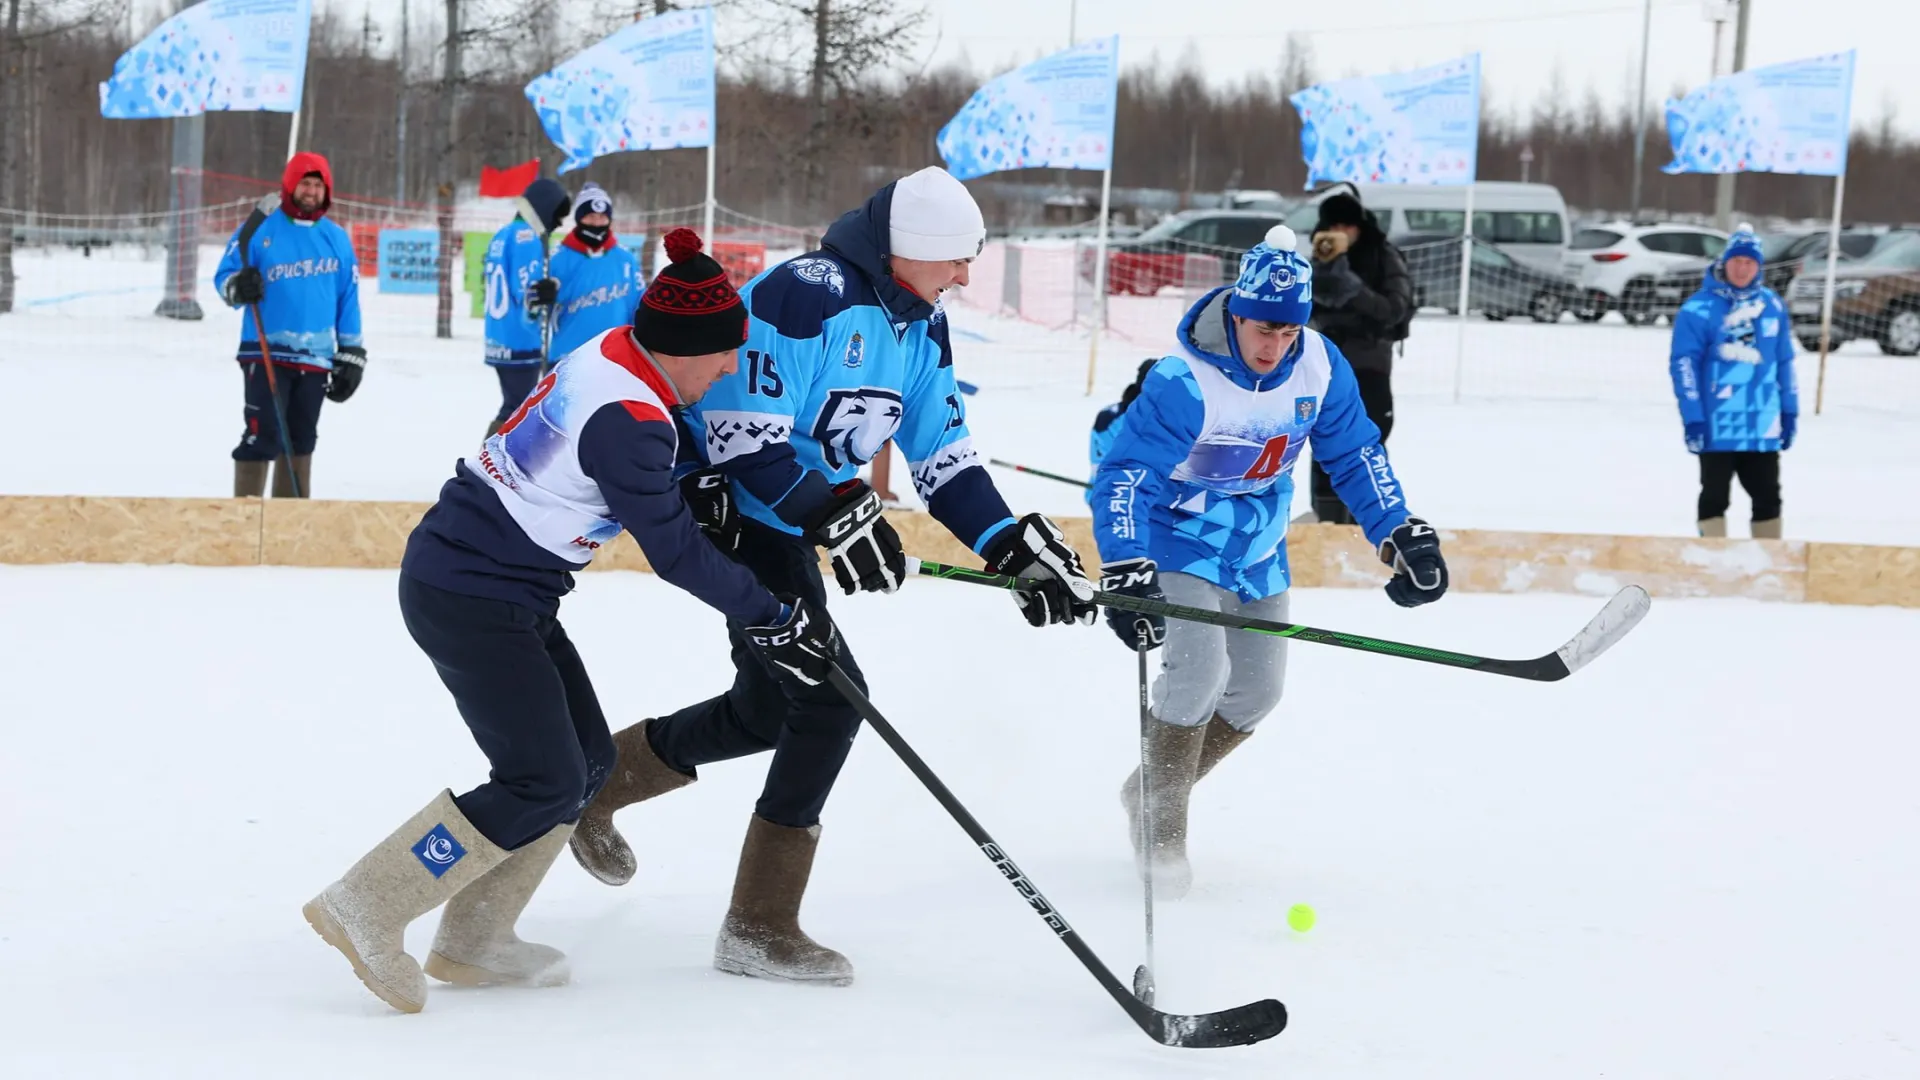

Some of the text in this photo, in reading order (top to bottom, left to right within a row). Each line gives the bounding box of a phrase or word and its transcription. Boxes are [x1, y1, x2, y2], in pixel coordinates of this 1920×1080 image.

[746, 350, 785, 399] 15
[1242, 432, 1290, 481] 4
[1371, 454, 1402, 508] ЯМАЛ
[997, 550, 1014, 571] CCM
[1102, 570, 1154, 592] CM
[752, 609, 810, 646] CCM
